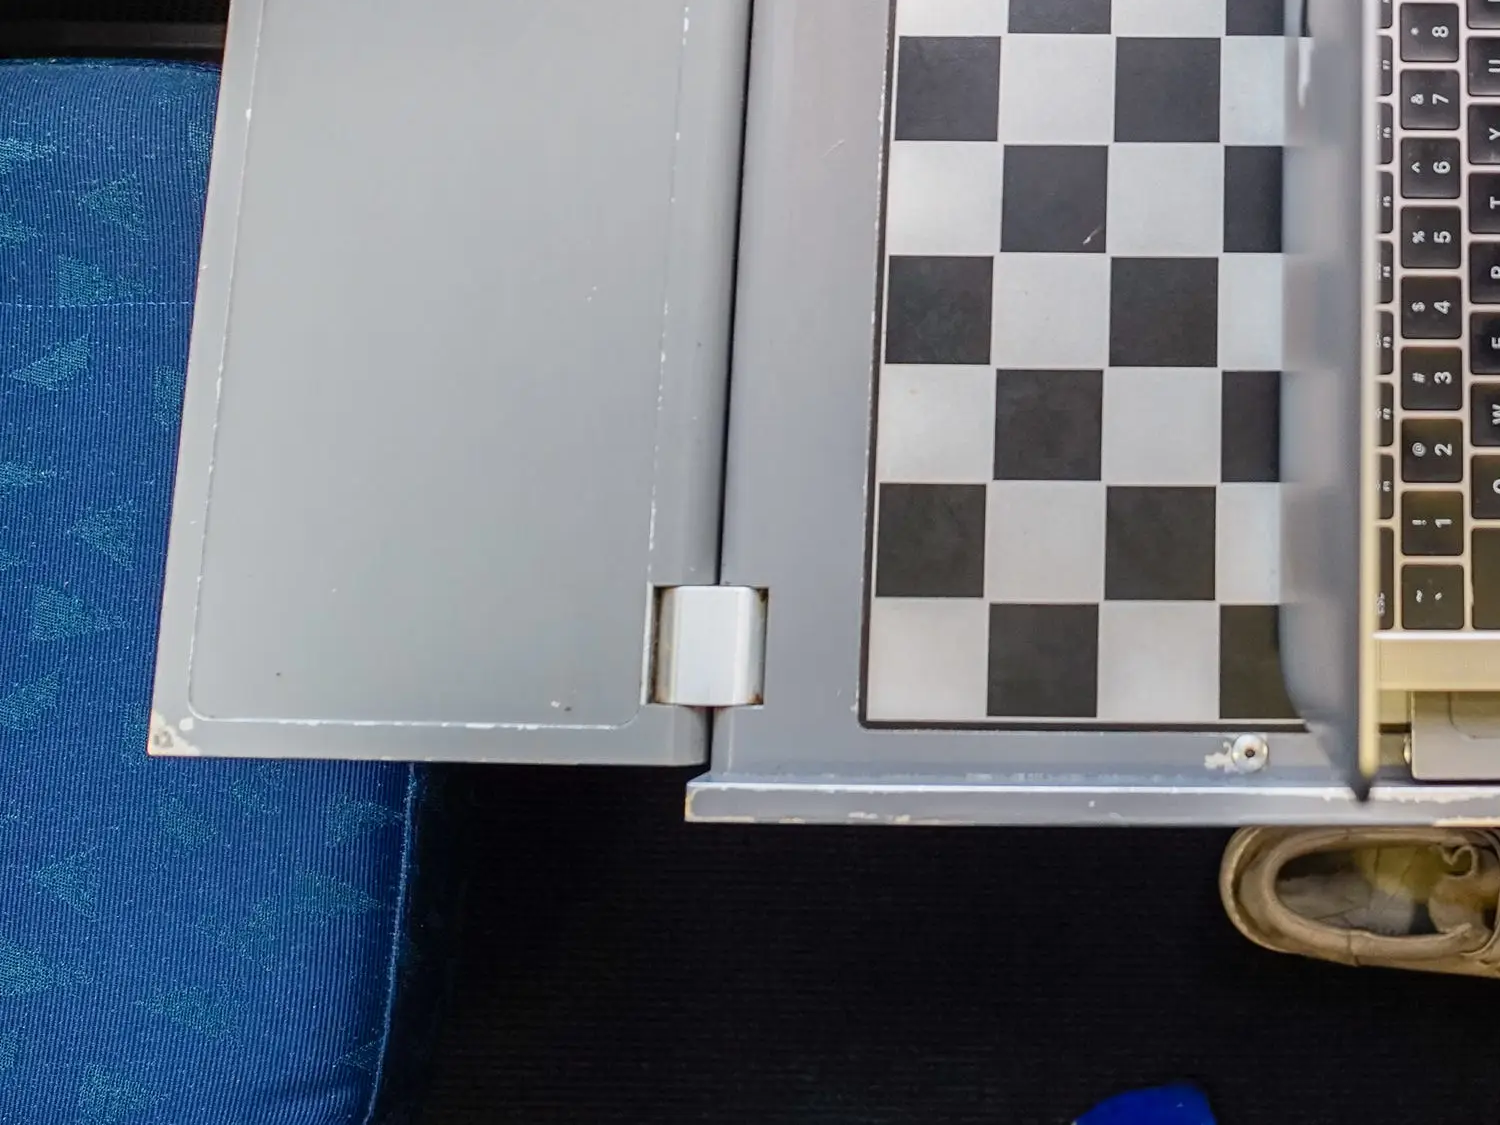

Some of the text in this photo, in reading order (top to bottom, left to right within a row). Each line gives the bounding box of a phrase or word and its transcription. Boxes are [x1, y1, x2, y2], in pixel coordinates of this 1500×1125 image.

[1432, 26, 1449, 38] 8
[1432, 94, 1449, 104] 7
[1433, 161, 1450, 174] 6
[1434, 231, 1451, 243] 5
[1434, 301, 1451, 314] 4
[1434, 372, 1452, 384] 3
[1434, 444, 1452, 456] 2
[1435, 519, 1452, 528] 1
